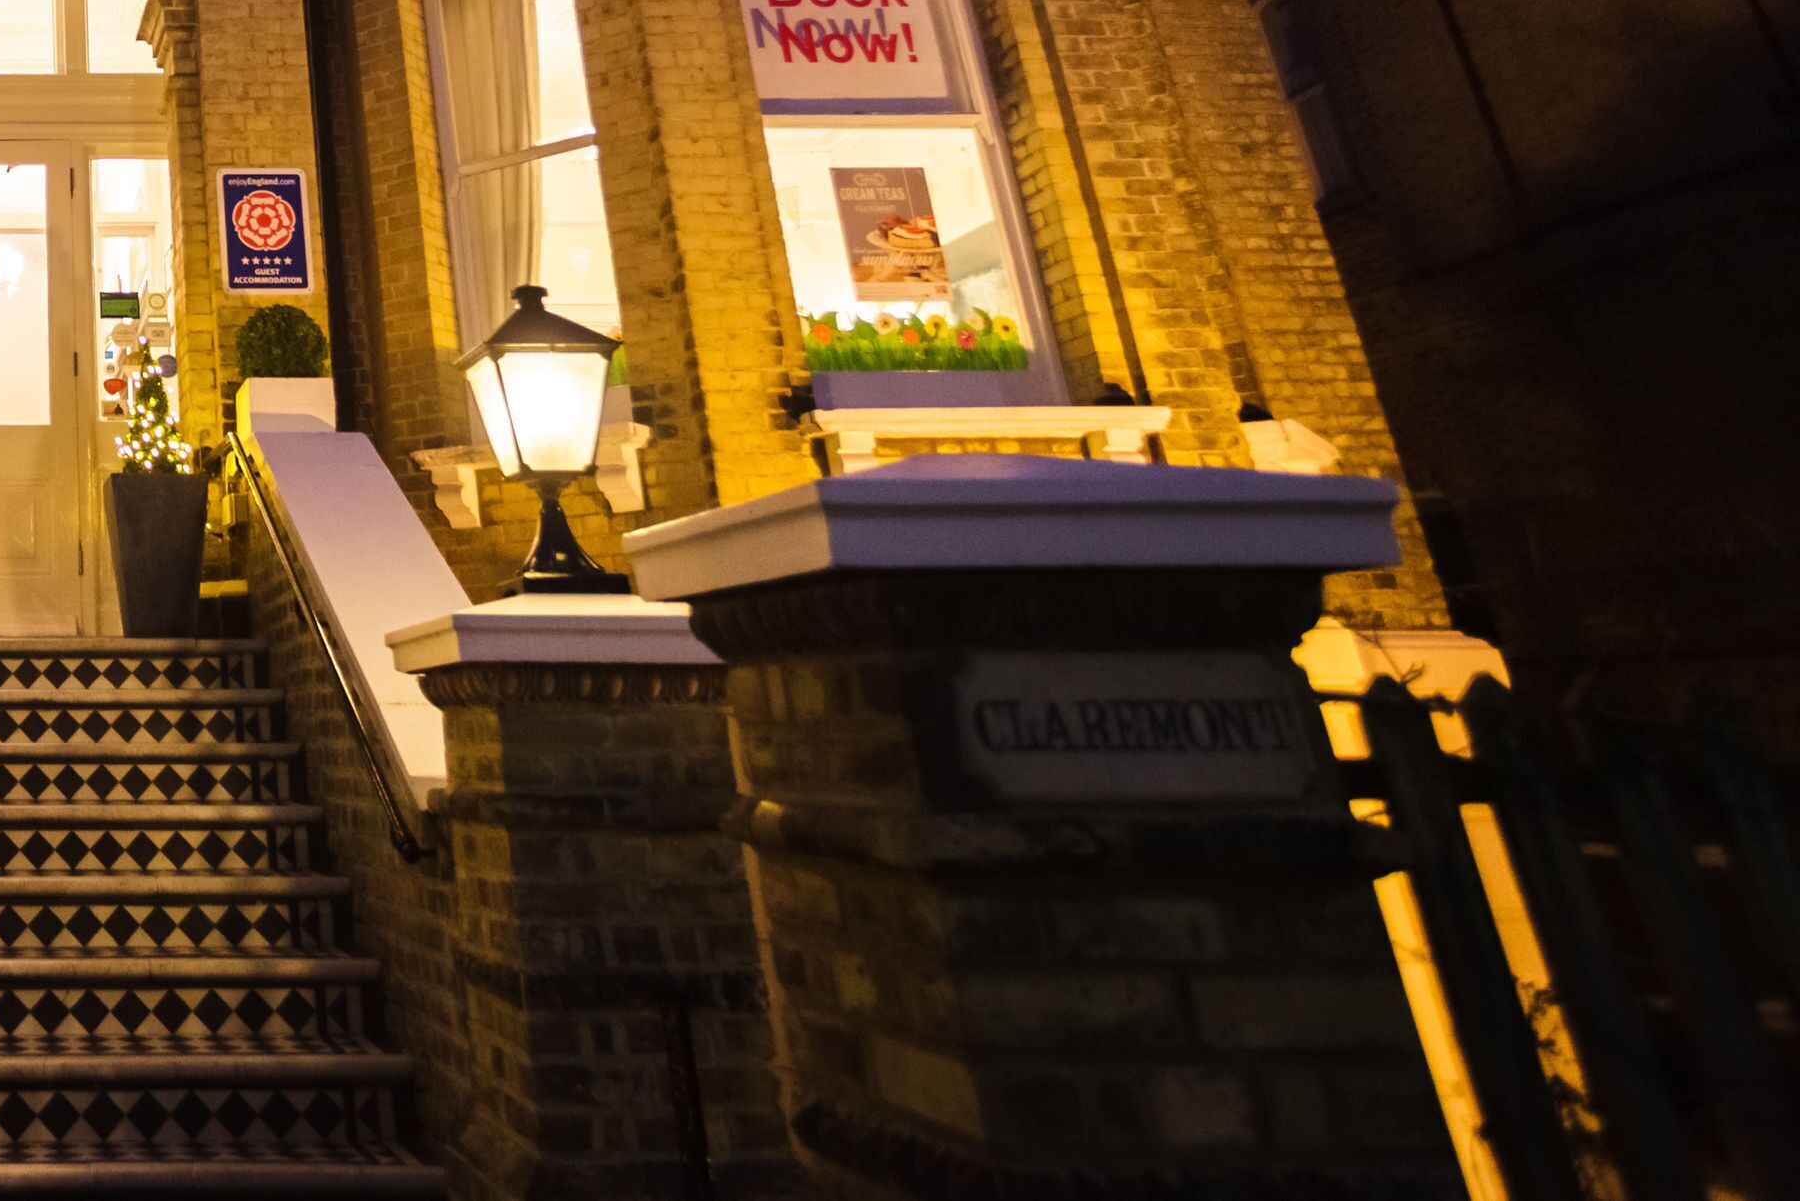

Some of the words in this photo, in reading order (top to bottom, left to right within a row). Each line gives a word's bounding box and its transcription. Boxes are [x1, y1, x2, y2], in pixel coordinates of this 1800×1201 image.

[777, 21, 920, 64] Now!
[228, 177, 296, 187] enjoyEngland.com
[839, 187, 876, 201] CREAM
[876, 187, 906, 200] TEAS
[254, 268, 280, 276] GUEST
[233, 276, 303, 284] ACCOMMODATION
[974, 698, 1294, 752] CLAREMONT
